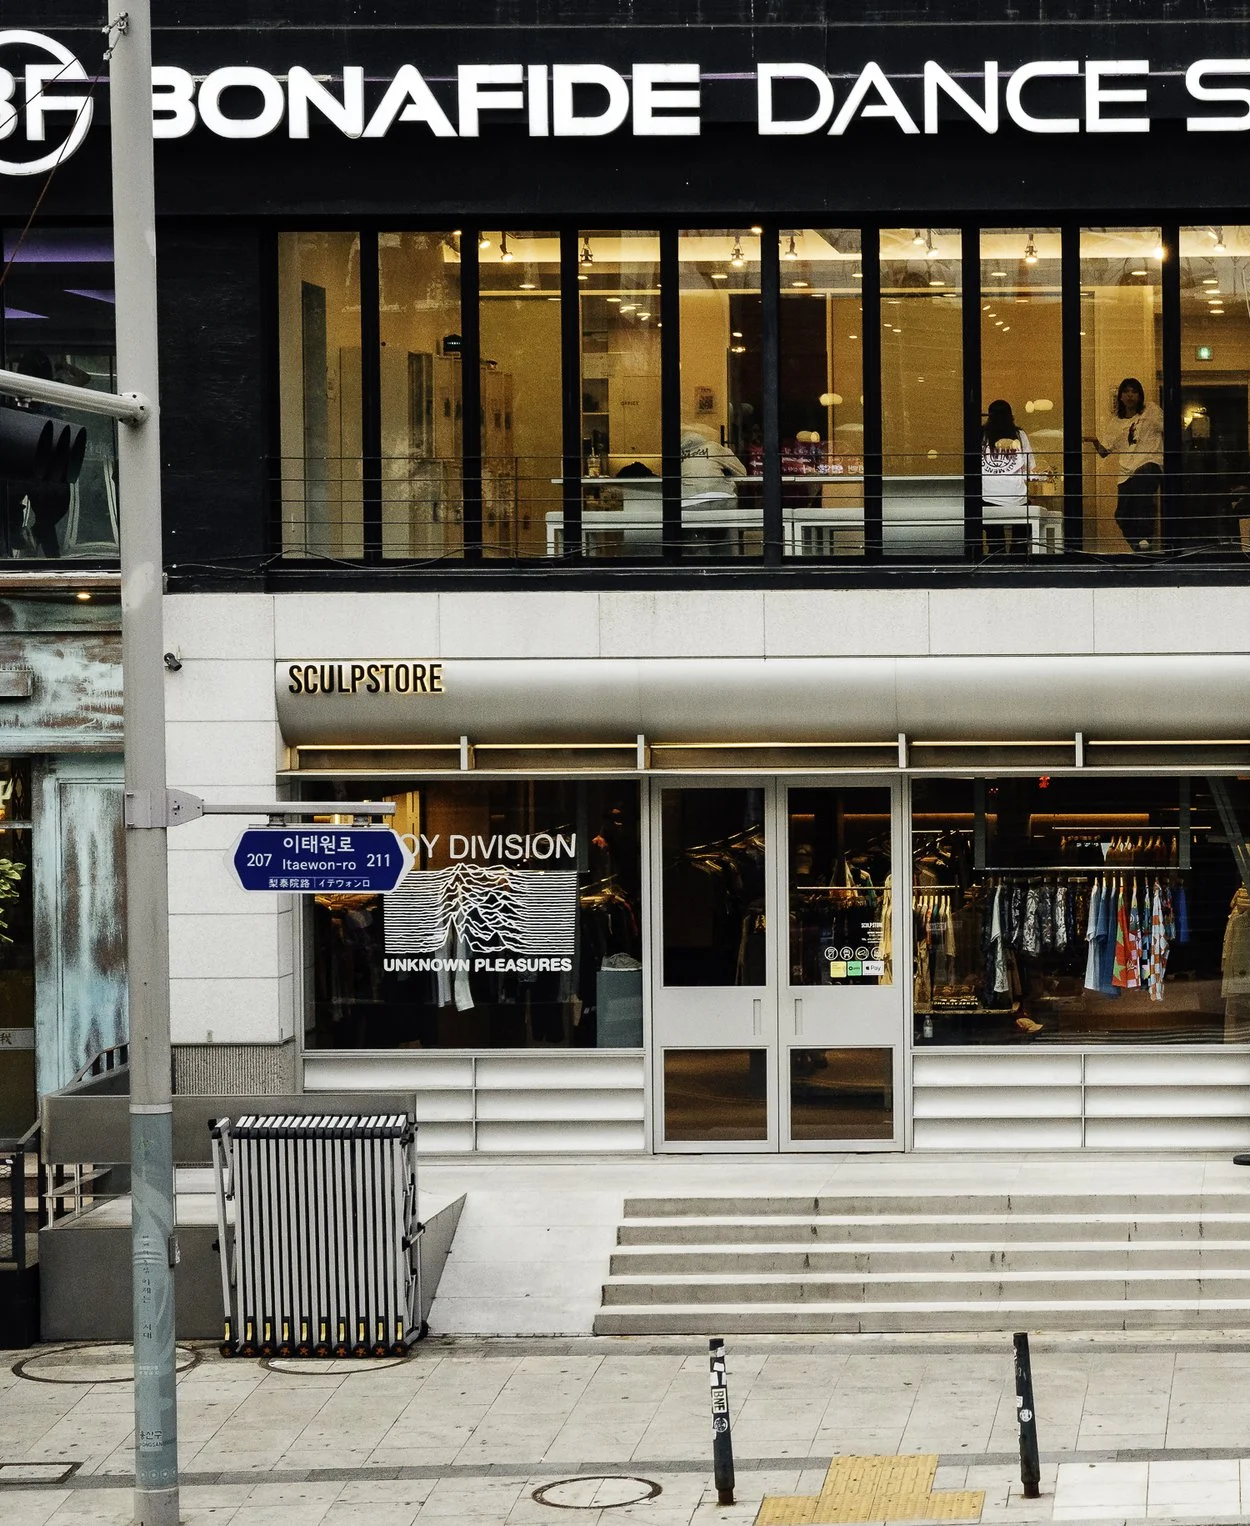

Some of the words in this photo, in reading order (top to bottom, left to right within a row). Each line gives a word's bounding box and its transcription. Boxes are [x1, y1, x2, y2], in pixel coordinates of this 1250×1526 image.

[153, 63, 701, 139] BONAFIDE
[758, 60, 1150, 135] DANCE
[288, 663, 443, 694] SCULPSTORE
[283, 835, 355, 854] 이태원로
[401, 835, 440, 860] OY
[449, 834, 576, 859] DIVISION
[247, 853, 272, 867] 207
[282, 859, 357, 871] Itaewon-ro
[366, 854, 390, 867] 211
[269, 878, 310, 888] 梨泰院路
[383, 958, 470, 972] UNKNOWN
[475, 958, 572, 972] PLEASURES
[713, 1390, 726, 1413] BNE
